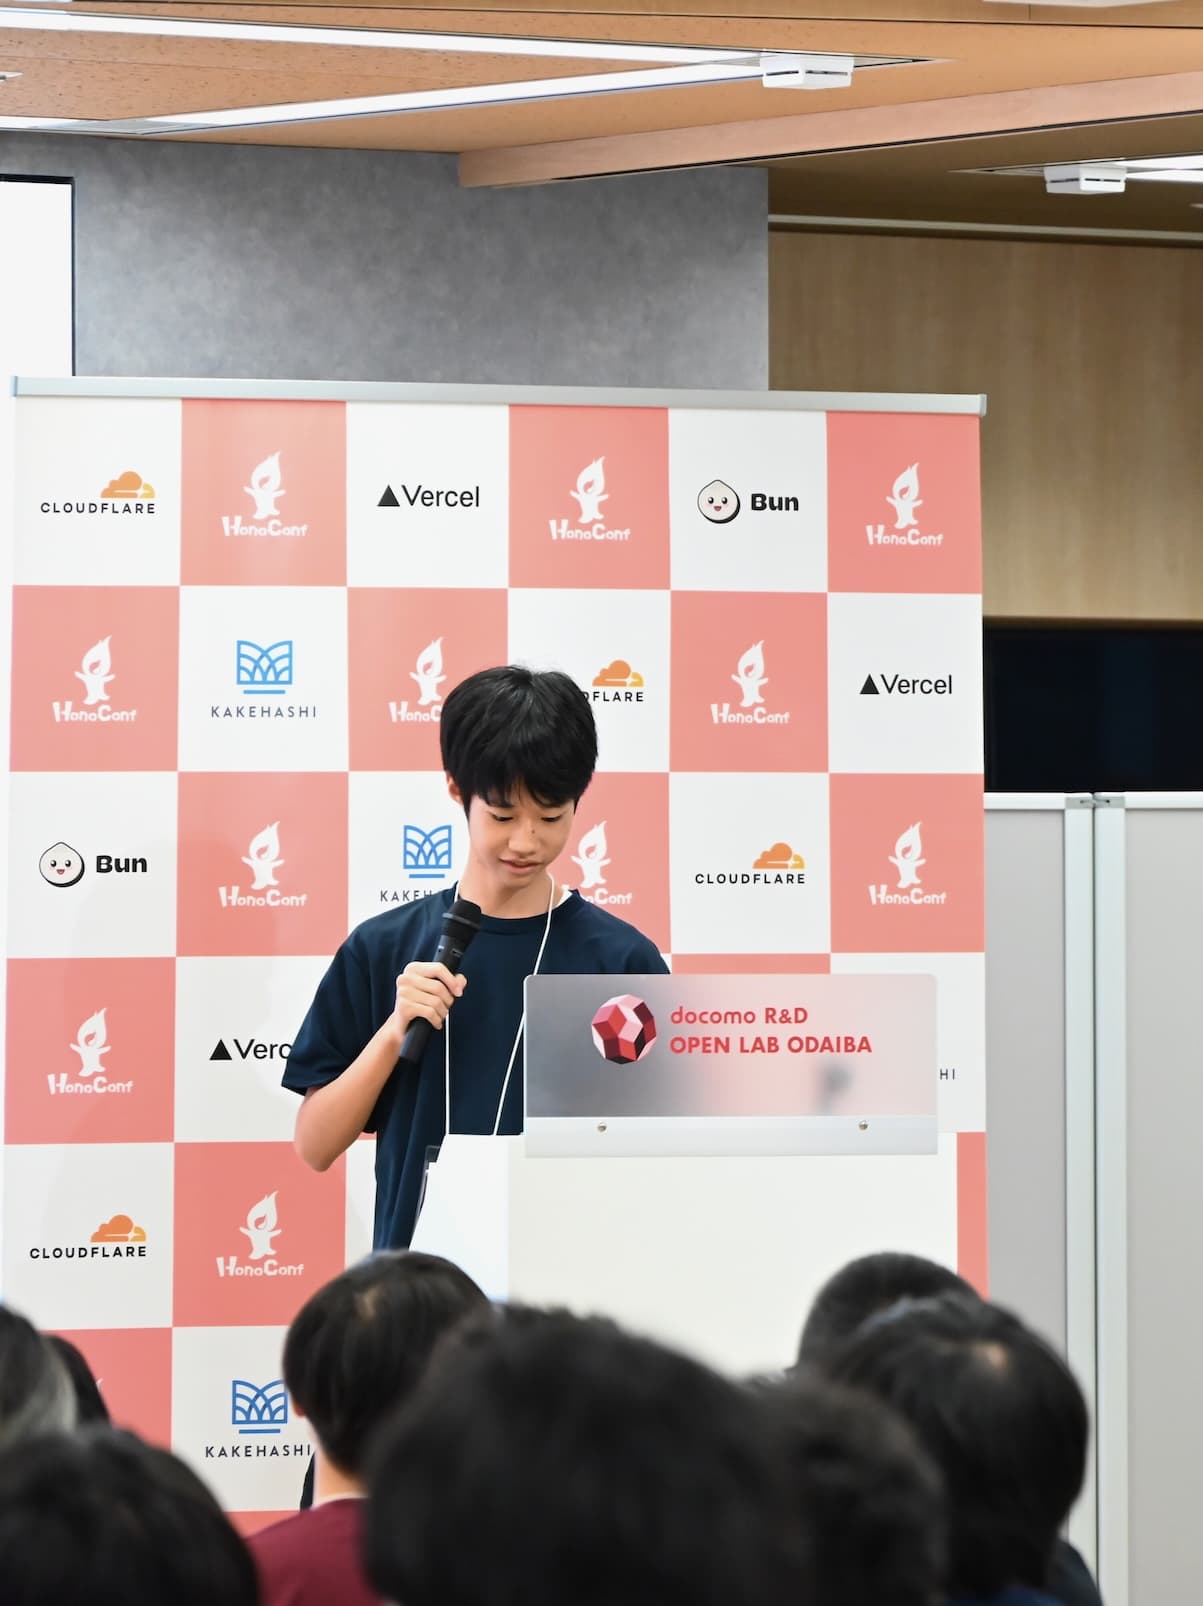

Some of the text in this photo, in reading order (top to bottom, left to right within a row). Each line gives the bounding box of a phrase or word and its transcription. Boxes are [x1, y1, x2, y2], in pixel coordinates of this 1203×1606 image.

[402, 485, 480, 508] Vercel
[751, 493, 799, 512] Bun
[40, 502, 155, 514] CLOUDFLARE
[221, 516, 308, 537] HonoConf
[548, 520, 631, 541] HonoConf
[865, 525, 943, 546] HonoConf
[881, 674, 952, 695] Vercel
[52, 702, 137, 722] HonoConf
[211, 706, 316, 718] KAKEHASHI
[388, 702, 441, 723] HonoC
[710, 703, 790, 724] HonoConf
[96, 855, 148, 874] Bun
[695, 873, 805, 885] CLOUDFLARE
[218, 886, 308, 907] HonoConf
[868, 884, 946, 905] HonoConf
[670, 1006, 809, 1025] docomo R&D
[233, 1039, 292, 1061] Verc
[669, 1035, 873, 1054] OPEN LAB ODAIBA
[47, 1073, 133, 1095] HonoConf
[29, 1246, 146, 1259] CLOUDFLARE
[216, 1256, 305, 1277] HonoConf
[205, 1445, 311, 1459] KAKEHASHI
